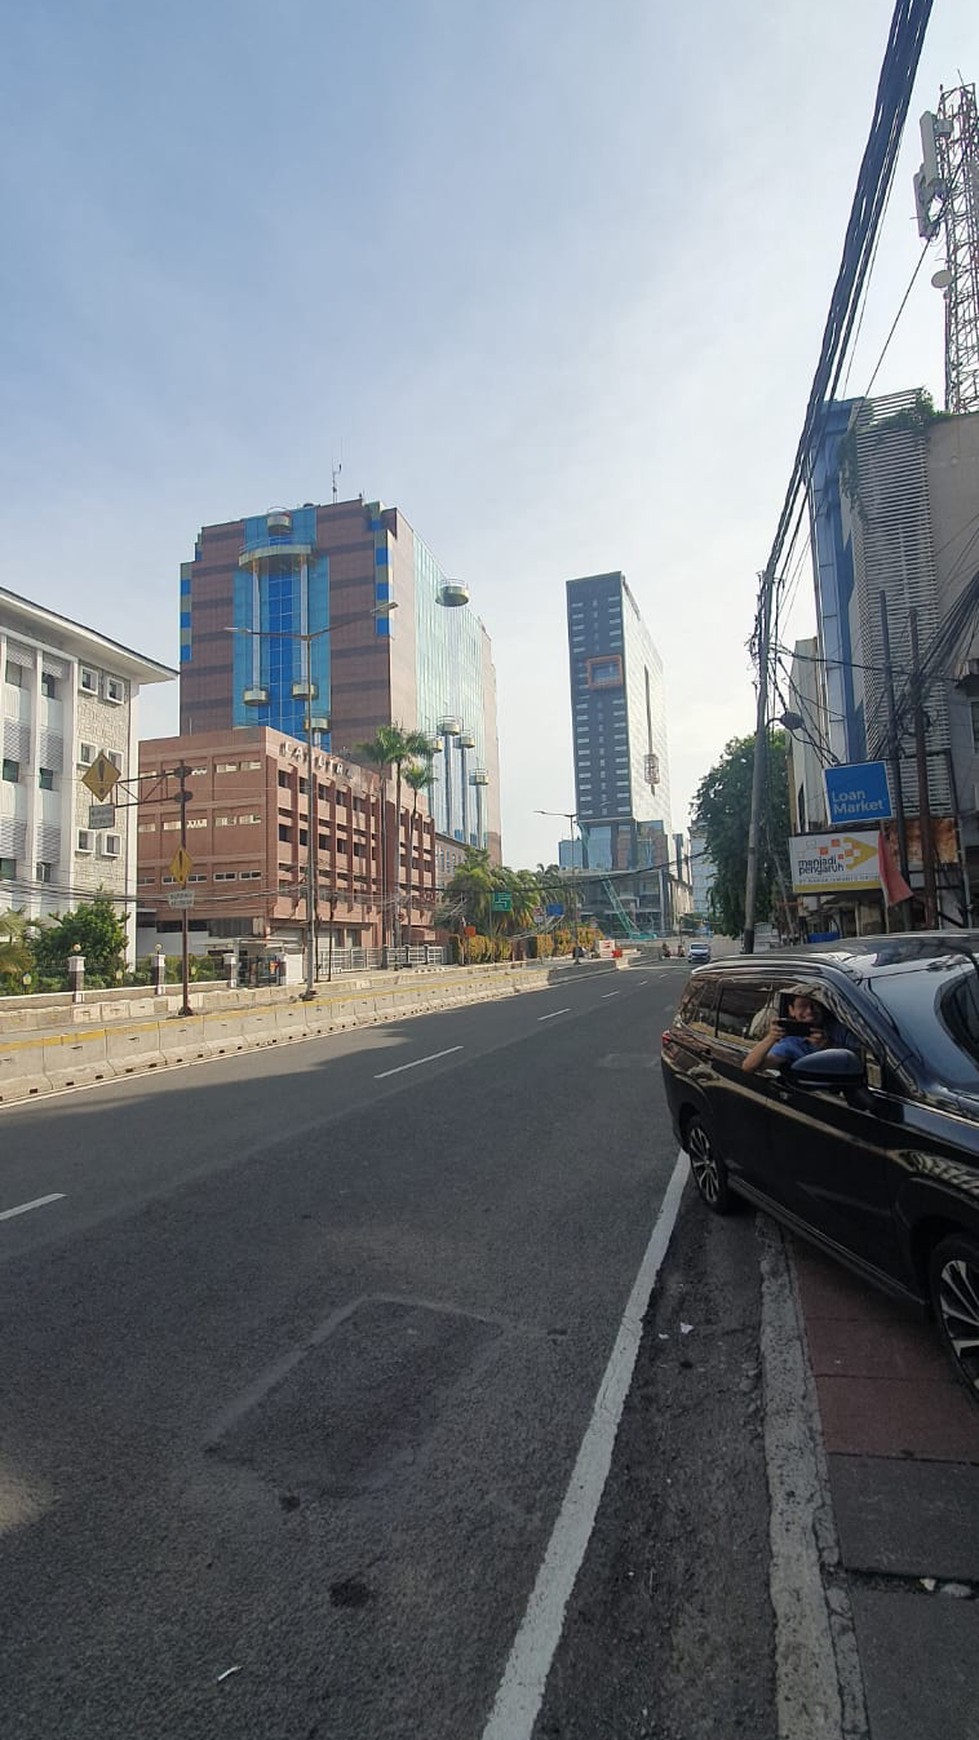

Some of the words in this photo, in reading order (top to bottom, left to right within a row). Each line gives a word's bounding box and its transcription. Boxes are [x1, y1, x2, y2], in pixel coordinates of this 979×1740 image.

[831, 789, 866, 803] Loan
[833, 799, 885, 815] Market
[798, 855, 837, 867] menjadi
[799, 862, 845, 876] pengaruh
